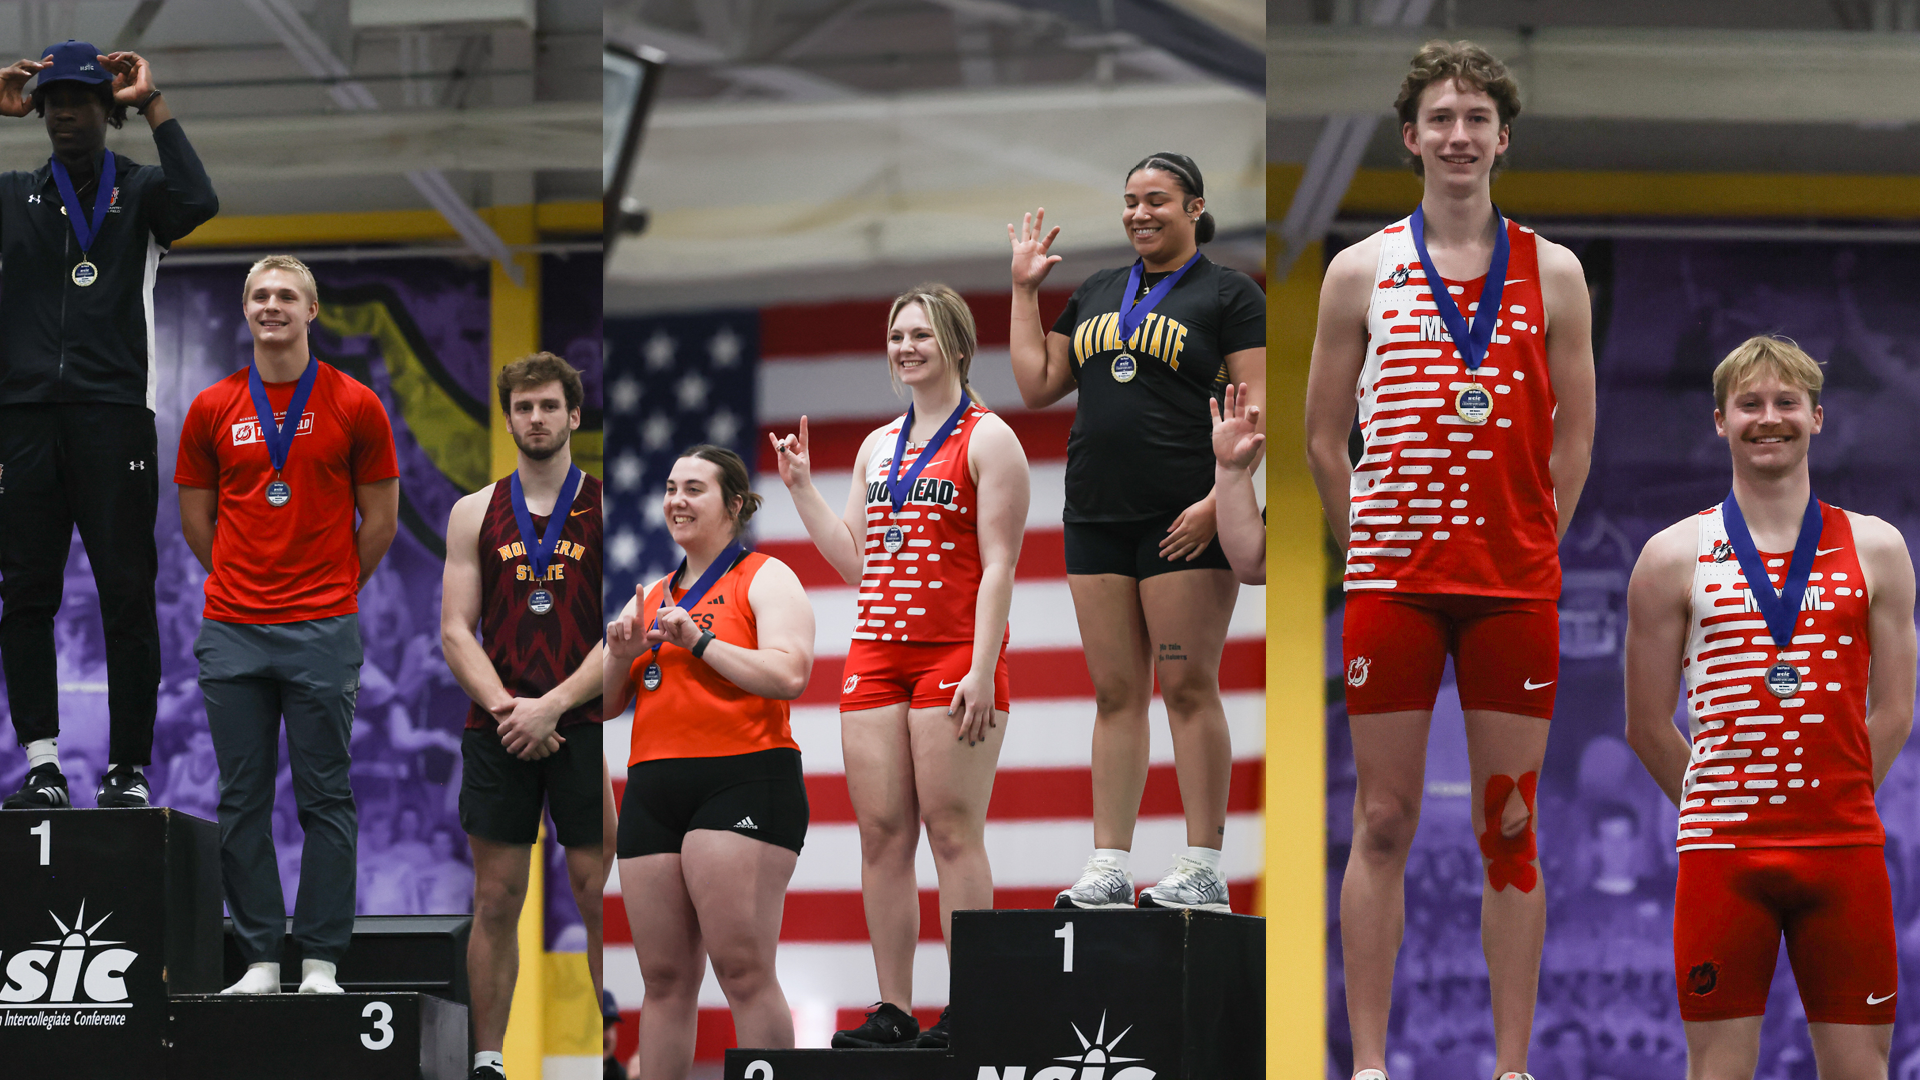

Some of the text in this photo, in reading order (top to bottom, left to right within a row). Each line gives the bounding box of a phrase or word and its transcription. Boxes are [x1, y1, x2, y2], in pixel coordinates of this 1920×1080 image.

[30, 820, 51, 865] 1
[1054, 921, 1074, 972] 1
[0, 948, 139, 1003] SIC
[4, 1010, 71, 1030] Intercollegiate
[73, 1010, 126, 1026] Conference
[360, 1001, 395, 1050] 3
